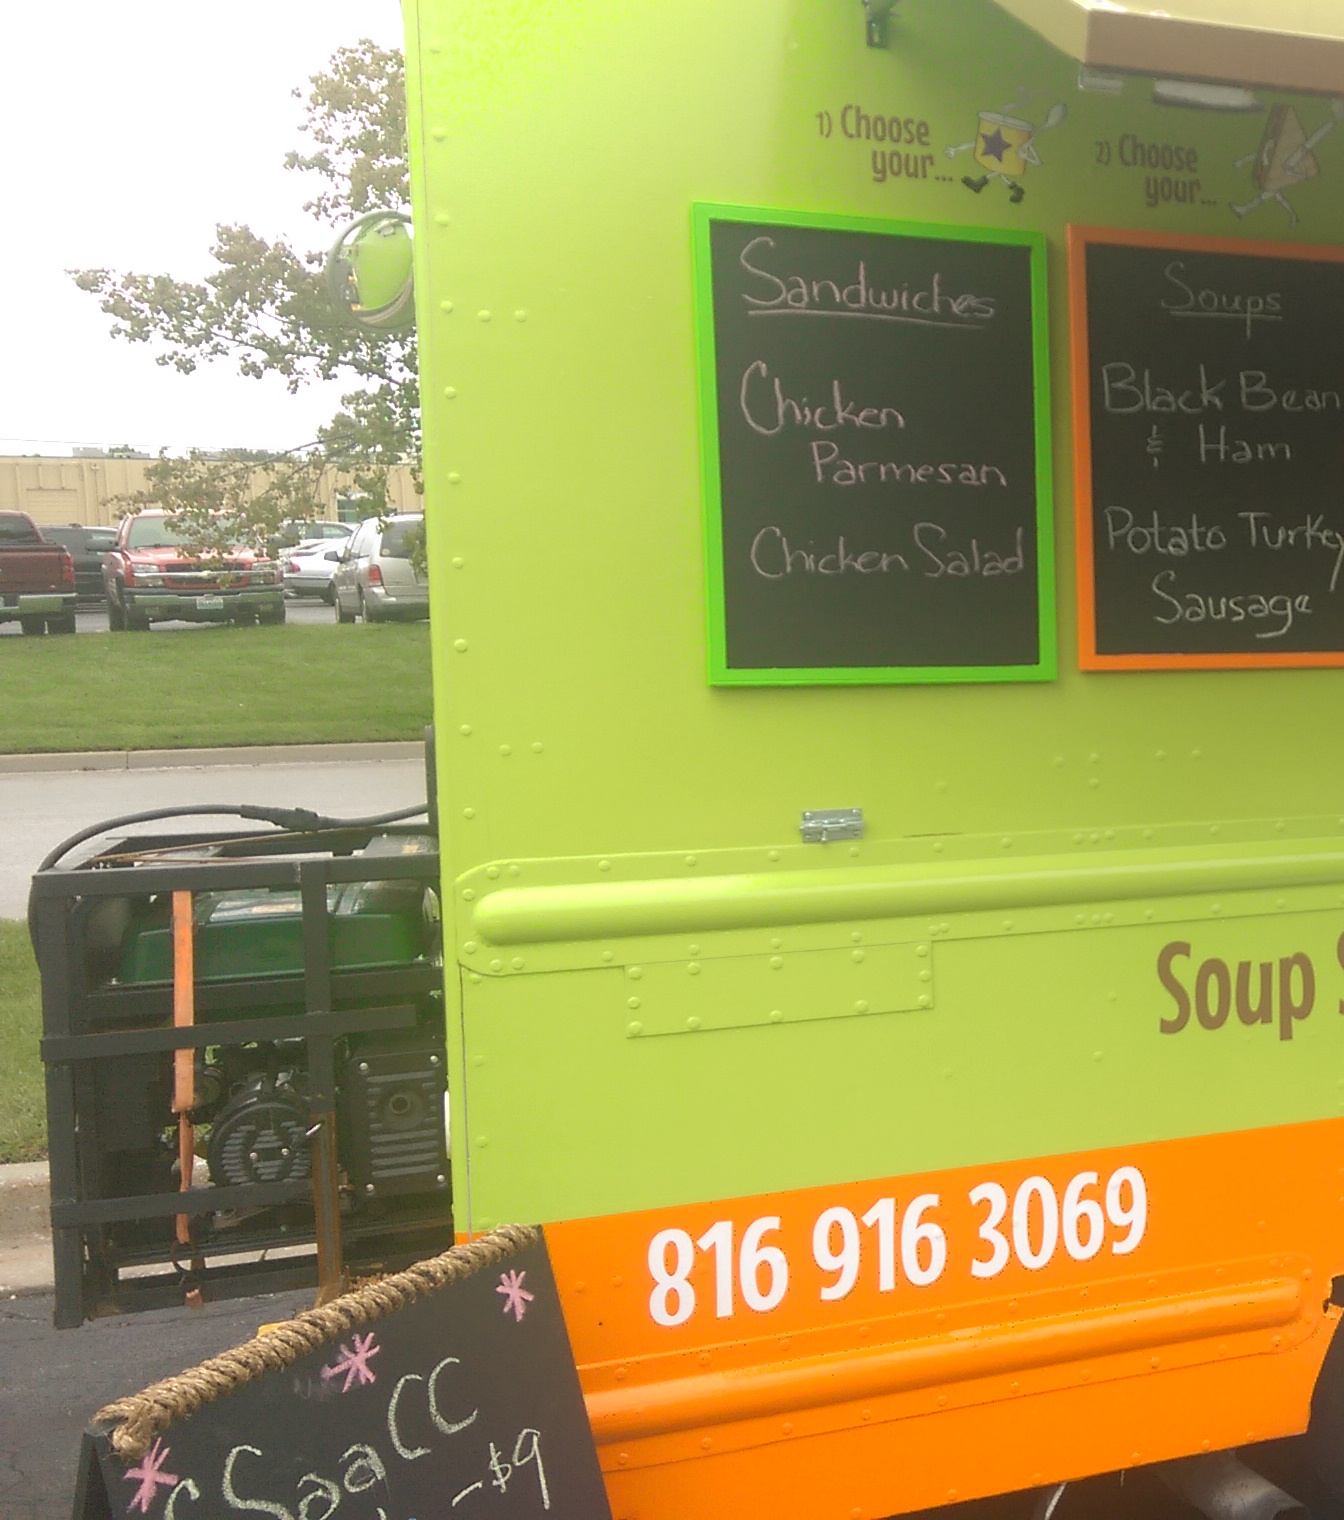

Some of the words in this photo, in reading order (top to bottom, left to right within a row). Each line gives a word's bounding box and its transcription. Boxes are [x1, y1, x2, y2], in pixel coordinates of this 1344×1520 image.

[815, 109, 832, 138] 1)
[840, 104, 931, 146] Choose
[1095, 141, 1111, 165] 2)
[1118, 134, 1198, 174] Choose
[741, 237, 995, 317] Sandwiches
[1161, 261, 1282, 340] Soups
[741, 361, 905, 435] Chicken
[1101, 362, 1226, 413] Black
[1240, 370, 1342, 413] Bean
[810, 441, 1008, 485] Parmesan
[1199, 424, 1291, 463] Ham
[751, 526, 908, 578] Chicken
[914, 522, 1025, 577] Salad
[1104, 505, 1227, 556] Potato
[1152, 570, 1313, 638] Sausage
[1155, 941, 1316, 1042] Soup
[648, 1216, 789, 1326] 816
[812, 1194, 947, 1301] 916
[969, 1166, 1148, 1278] 3069
